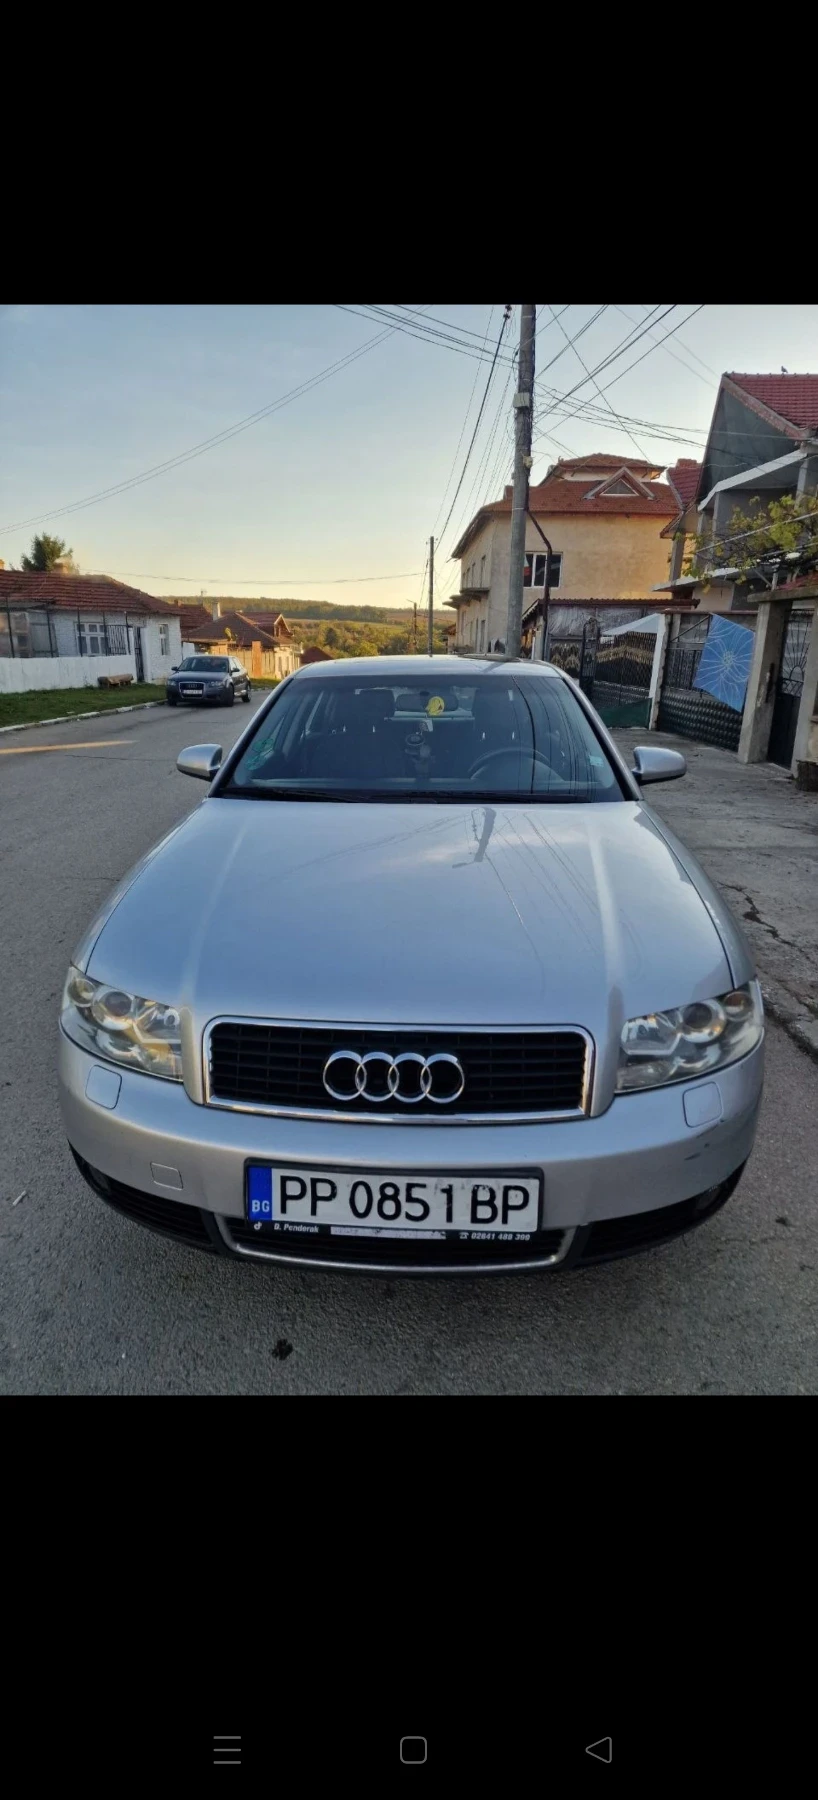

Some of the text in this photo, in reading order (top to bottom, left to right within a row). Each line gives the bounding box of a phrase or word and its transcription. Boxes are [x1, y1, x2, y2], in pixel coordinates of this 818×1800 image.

[251, 1199, 270, 1213] BG
[280, 1175, 530, 1226] PP 0851 BP
